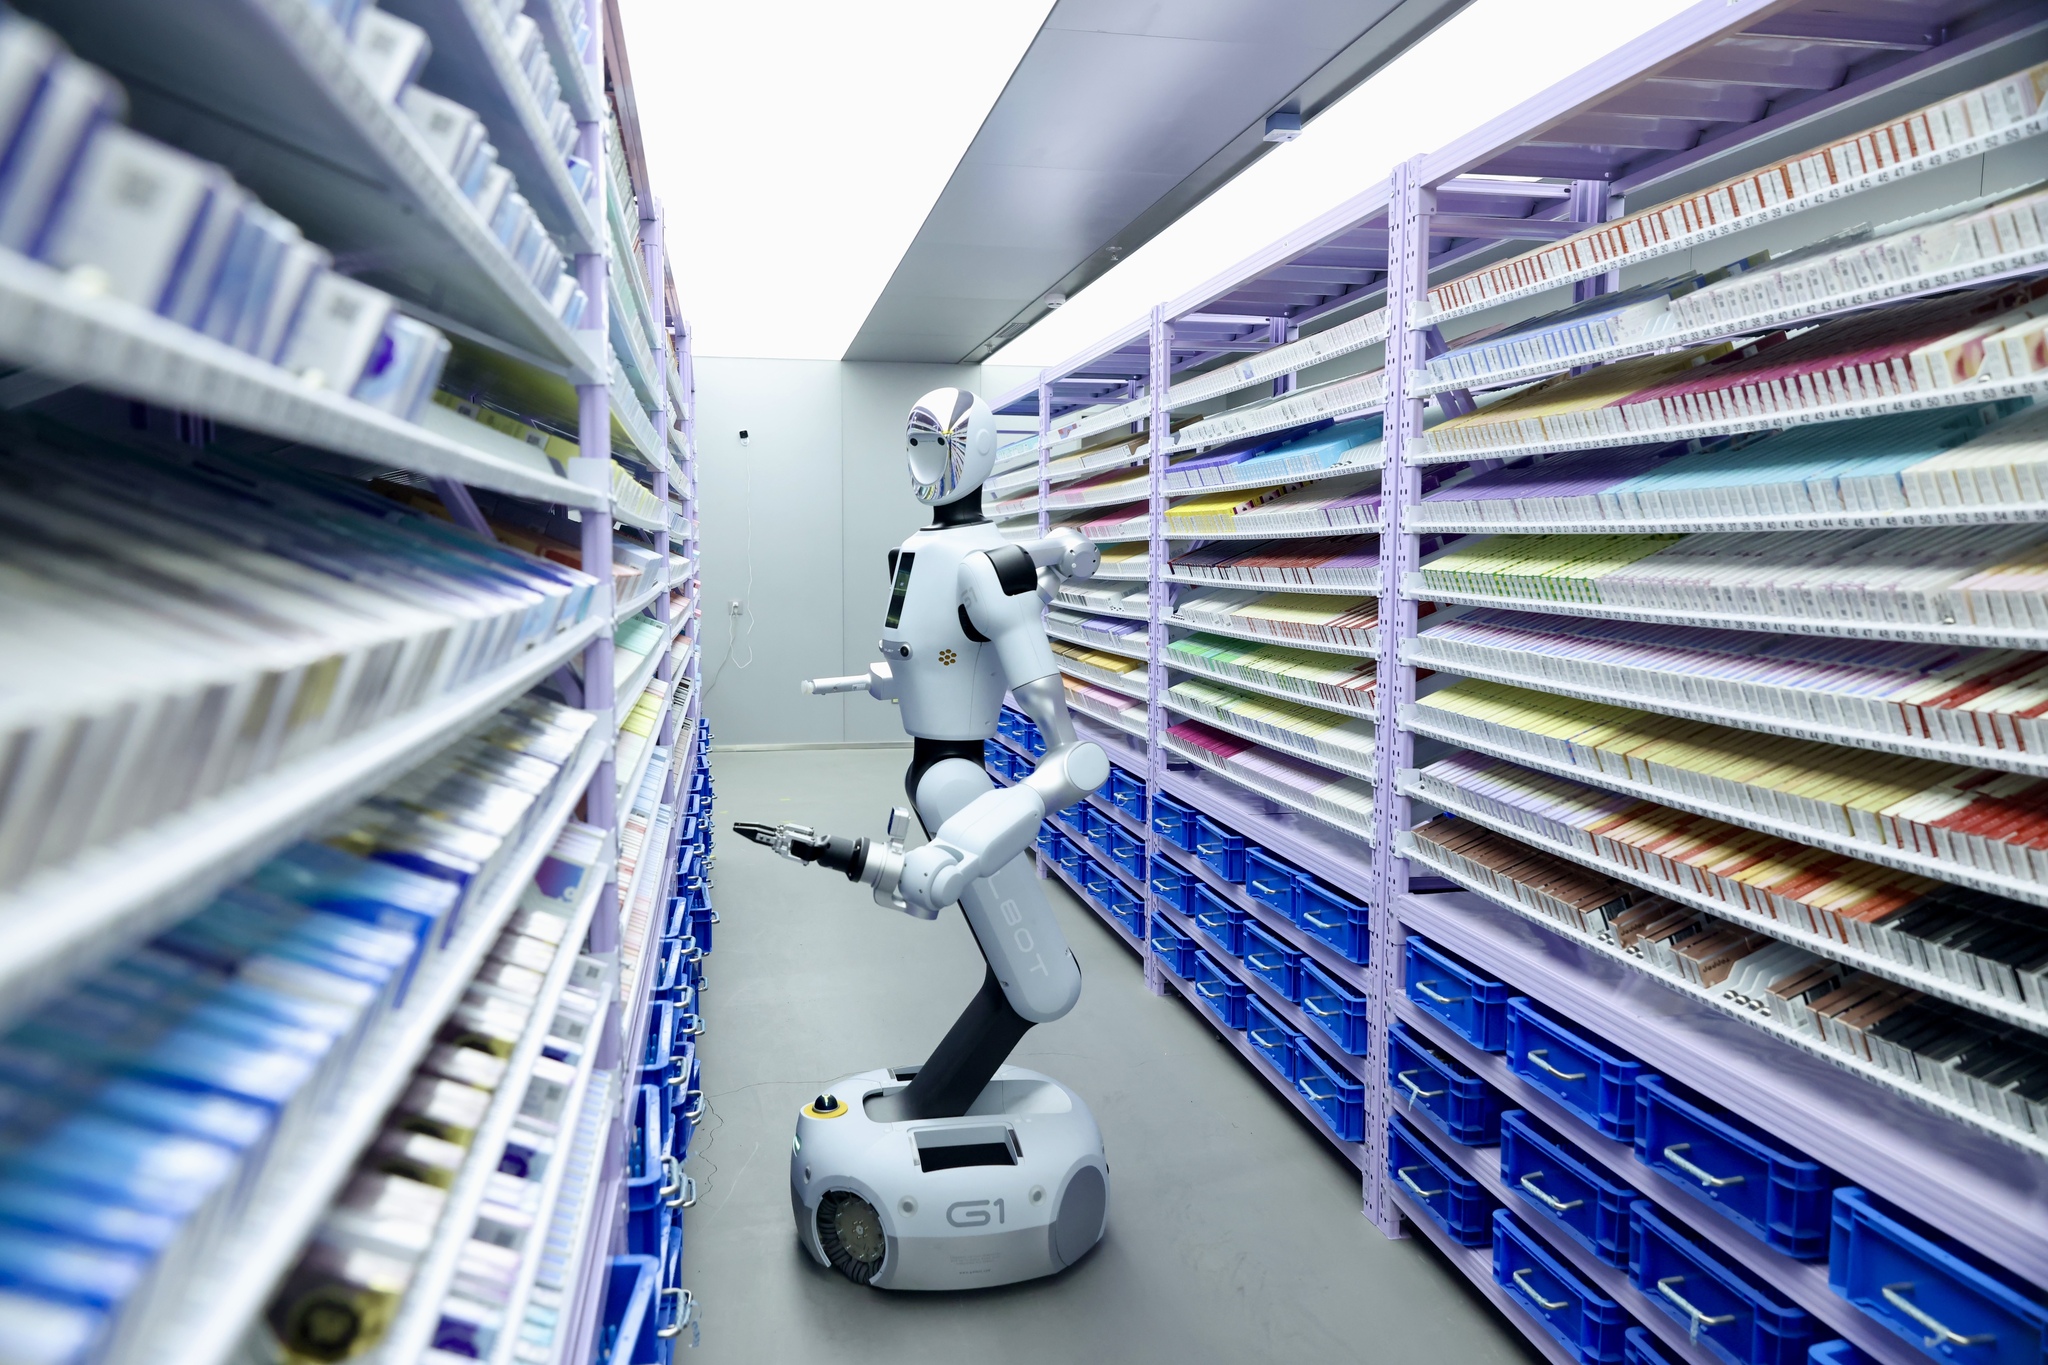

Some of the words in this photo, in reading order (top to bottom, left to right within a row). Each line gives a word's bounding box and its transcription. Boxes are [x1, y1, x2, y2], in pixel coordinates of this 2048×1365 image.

[1673, 240, 1681, 250] 31
[1684, 236, 1693, 246] 32
[1696, 232, 1705, 242] 33
[1708, 229, 1716, 239] 34
[1719, 224, 1729, 235] 35
[1732, 220, 1741, 231] 36
[1745, 215, 1753, 226] 37
[1758, 211, 1768, 222] 38
[1771, 207, 1781, 218] 39
[1785, 202, 1795, 212] 40
[1799, 198, 1808, 208] 41
[1813, 193, 1823, 203] 42
[1828, 188, 1839, 198] 43
[1844, 183, 1854, 193] 44
[1859, 178, 1870, 188] 45
[1877, 171, 1889, 182] 46
[1894, 166, 1905, 177] 47
[1911, 160, 1923, 171] 48
[1928, 154, 1941, 166] 49
[1946, 148, 1960, 161] 50
[1964, 142, 1978, 154] 51
[1984, 135, 1998, 148] 52
[2004, 127, 2020, 142] 53
[2026, 120, 2041, 135] 54
[1668, 336, 1676, 346] 31
[1679, 333, 1687, 343] 32
[1690, 331, 1699, 340] 33
[1702, 328, 1710, 338] 34
[1714, 325, 1723, 335] 35
[1726, 322, 1735, 332] 36
[1738, 319, 1747, 330] 37
[1751, 317, 1761, 327] 38
[1764, 314, 1774, 324] 39
[1778, 310, 1788, 320] 40
[1791, 307, 1801, 317] 41
[1806, 304, 1816, 314] 42
[1820, 301, 1831, 311] 43
[1835, 298, 1846, 308] 44
[1851, 294, 1862, 304] 45
[1867, 290, 1878, 300] 46
[1883, 286, 1894, 296] 47
[1900, 282, 1912, 293] 48
[1917, 278, 1930, 289] 49
[1934, 274, 1948, 286] 50
[1952, 270, 1965, 282] 51
[1971, 265, 1985, 278] 52
[1990, 260, 2006, 273] 53
[2011, 256, 2026, 269] 54
[1664, 432, 1671, 440] 31
[1674, 430, 1683, 439] 32
[1685, 429, 1695, 438] 33
[1697, 428, 1706, 437] 34
[1709, 426, 1718, 435] 35
[1721, 425, 1730, 434] 36
[1733, 423, 1742, 432] 37
[1746, 421, 1755, 431] 38
[1759, 419, 1769, 429] 39
[1772, 418, 1782, 426] 40
[1786, 415, 1795, 424] 41
[1800, 413, 1810, 423] 42
[1814, 411, 1825, 420] 43
[1829, 409, 1839, 418] 44
[1844, 407, 1855, 416] 45
[1860, 406, 1871, 415] 46
[1876, 403, 1886, 413] 47
[1892, 401, 1904, 411] 48
[1909, 398, 1922, 409] 49
[1926, 396, 1940, 407] 50
[1944, 393, 1956, 404] 51
[1962, 391, 1976, 402] 52
[1981, 388, 1996, 399] 53
[2001, 385, 2016, 396] 54
[2021, 382, 2037, 393] 55
[1659, 524, 1667, 532] 31
[1670, 524, 1679, 532] 32
[1681, 523, 1690, 532] 33
[1693, 523, 1701, 532] 34
[1704, 523, 1713, 532] 35
[1716, 523, 1725, 531] 36
[1728, 522, 1737, 531] 37
[1740, 522, 1750, 530] 38
[1753, 521, 1763, 530] 39
[1766, 521, 1776, 529] 40
[1780, 520, 1789, 529] 41
[1794, 519, 1804, 528] 42
[1808, 519, 1818, 528] 43
[1822, 518, 1833, 527] 44
[1837, 517, 1848, 526] 45
[1853, 518, 1864, 527] 46
[1869, 517, 1879, 526] 47
[1885, 516, 1897, 526] 48
[1902, 515, 1914, 525] 49
[1918, 514, 1932, 524] 50
[1936, 513, 1949, 524] 51
[1955, 512, 1968, 523] 52
[1973, 511, 1988, 522] 53
[1993, 511, 2007, 522] 54
[2013, 510, 2029, 521] 55
[1654, 614, 1662, 623] 31
[1665, 615, 1673, 624] 32
[1676, 616, 1685, 625] 33
[1687, 617, 1696, 625] 34
[1698, 617, 1707, 626] 35
[1710, 618, 1719, 627] 36
[1722, 619, 1731, 628] 37
[1734, 620, 1744, 629] 38
[1747, 621, 1757, 630] 39
[1760, 622, 1770, 630] 40
[1773, 622, 1782, 631] 41
[1787, 623, 1796, 632] 42
[1800, 624, 1811, 633] 43
[1815, 624, 1825, 634] 44
[1829, 625, 1840, 635] 45
[1846, 627, 1858, 637] 46
[1862, 627, 1872, 637] 47
[1878, 629, 1890, 639] 48
[1895, 630, 1907, 640] 49
[1911, 630, 1925, 641] 50
[1928, 631, 1941, 642] 51
[1947, 633, 1960, 644] 52
[1965, 634, 1980, 645] 53
[1985, 635, 1999, 646] 54
[1650, 703, 1658, 712] 31
[1661, 706, 1669, 715] 32
[1671, 708, 1680, 717] 33
[1682, 710, 1691, 718] 34
[1694, 712, 1703, 721] 35
[1705, 714, 1715, 723] 36
[1717, 716, 1726, 725] 37
[1729, 718, 1739, 727] 38
[1742, 720, 1752, 730] 39
[1755, 723, 1764, 732] 40
[1768, 724, 1776, 733] 41
[1781, 727, 1791, 736] 42
[1795, 729, 1805, 738] 43
[1809, 731, 1819, 740] 44
[1823, 733, 1834, 742] 45
[1840, 736, 1851, 745] 46
[1855, 738, 1865, 747] 47
[1871, 740, 1882, 750] 48
[1887, 743, 1899, 753] 49
[1903, 744, 1916, 756] 50
[1920, 747, 1932, 758] 51
[1938, 750, 1951, 761] 52
[1956, 752, 1971, 764] 53
[1975, 755, 1989, 767] 54
[946, 1197, 1005, 1228] G1
